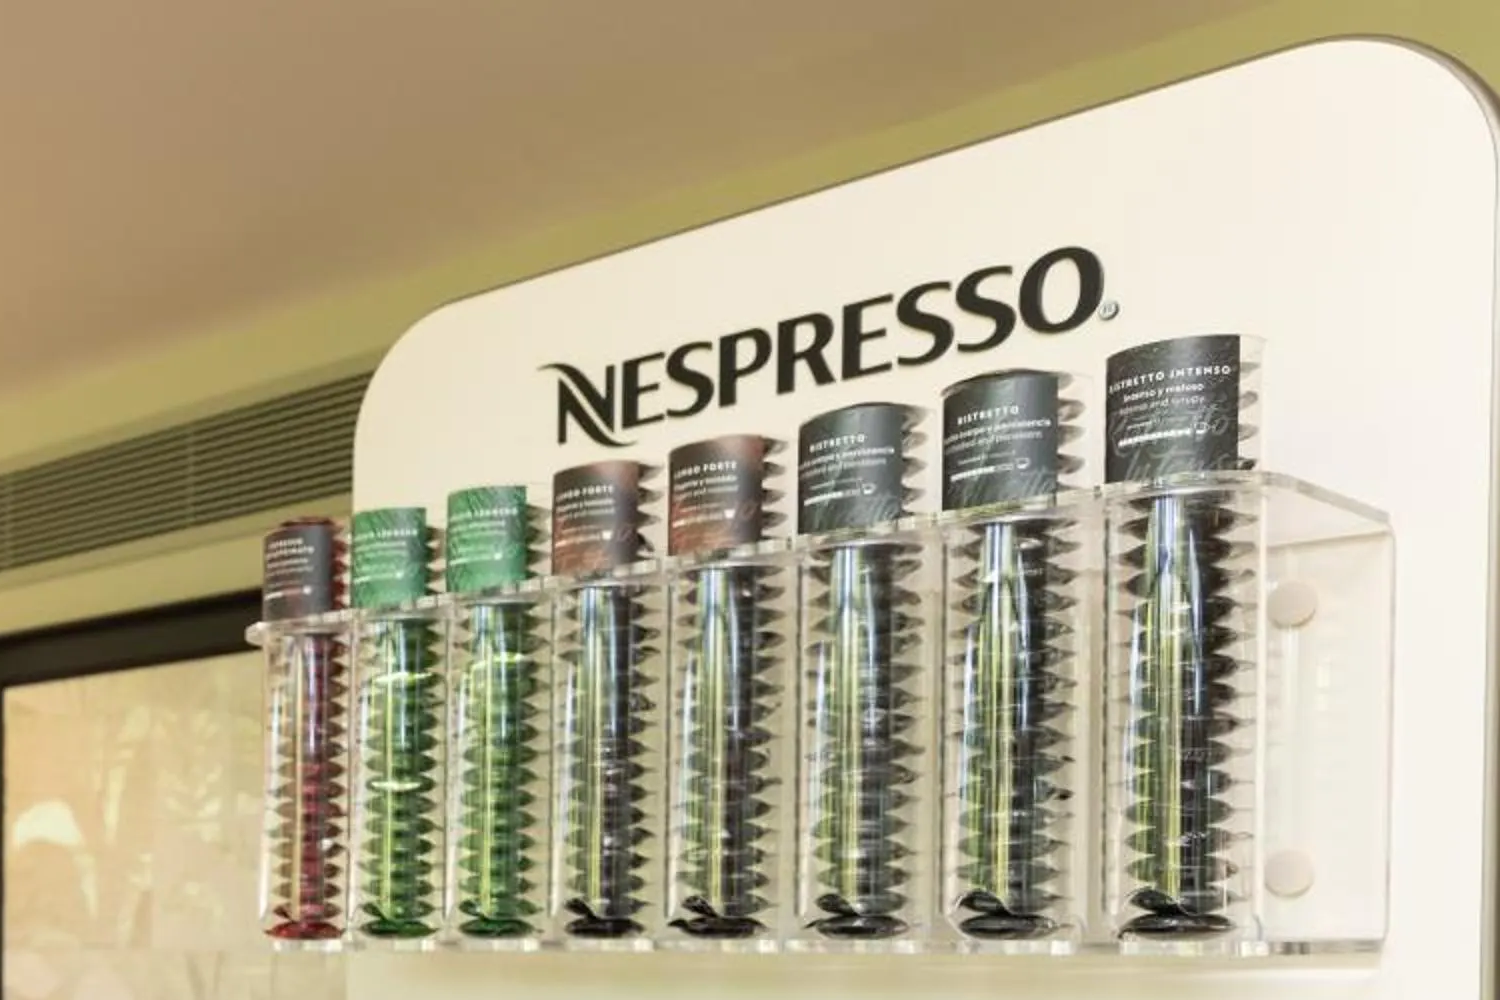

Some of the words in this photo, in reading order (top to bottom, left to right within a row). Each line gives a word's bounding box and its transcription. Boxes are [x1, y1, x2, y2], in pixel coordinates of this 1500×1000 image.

[537, 246, 1104, 446] NESPRESSO
[1169, 365, 1231, 379] INTENSO
[957, 405, 1019, 425] RISTRETTO
